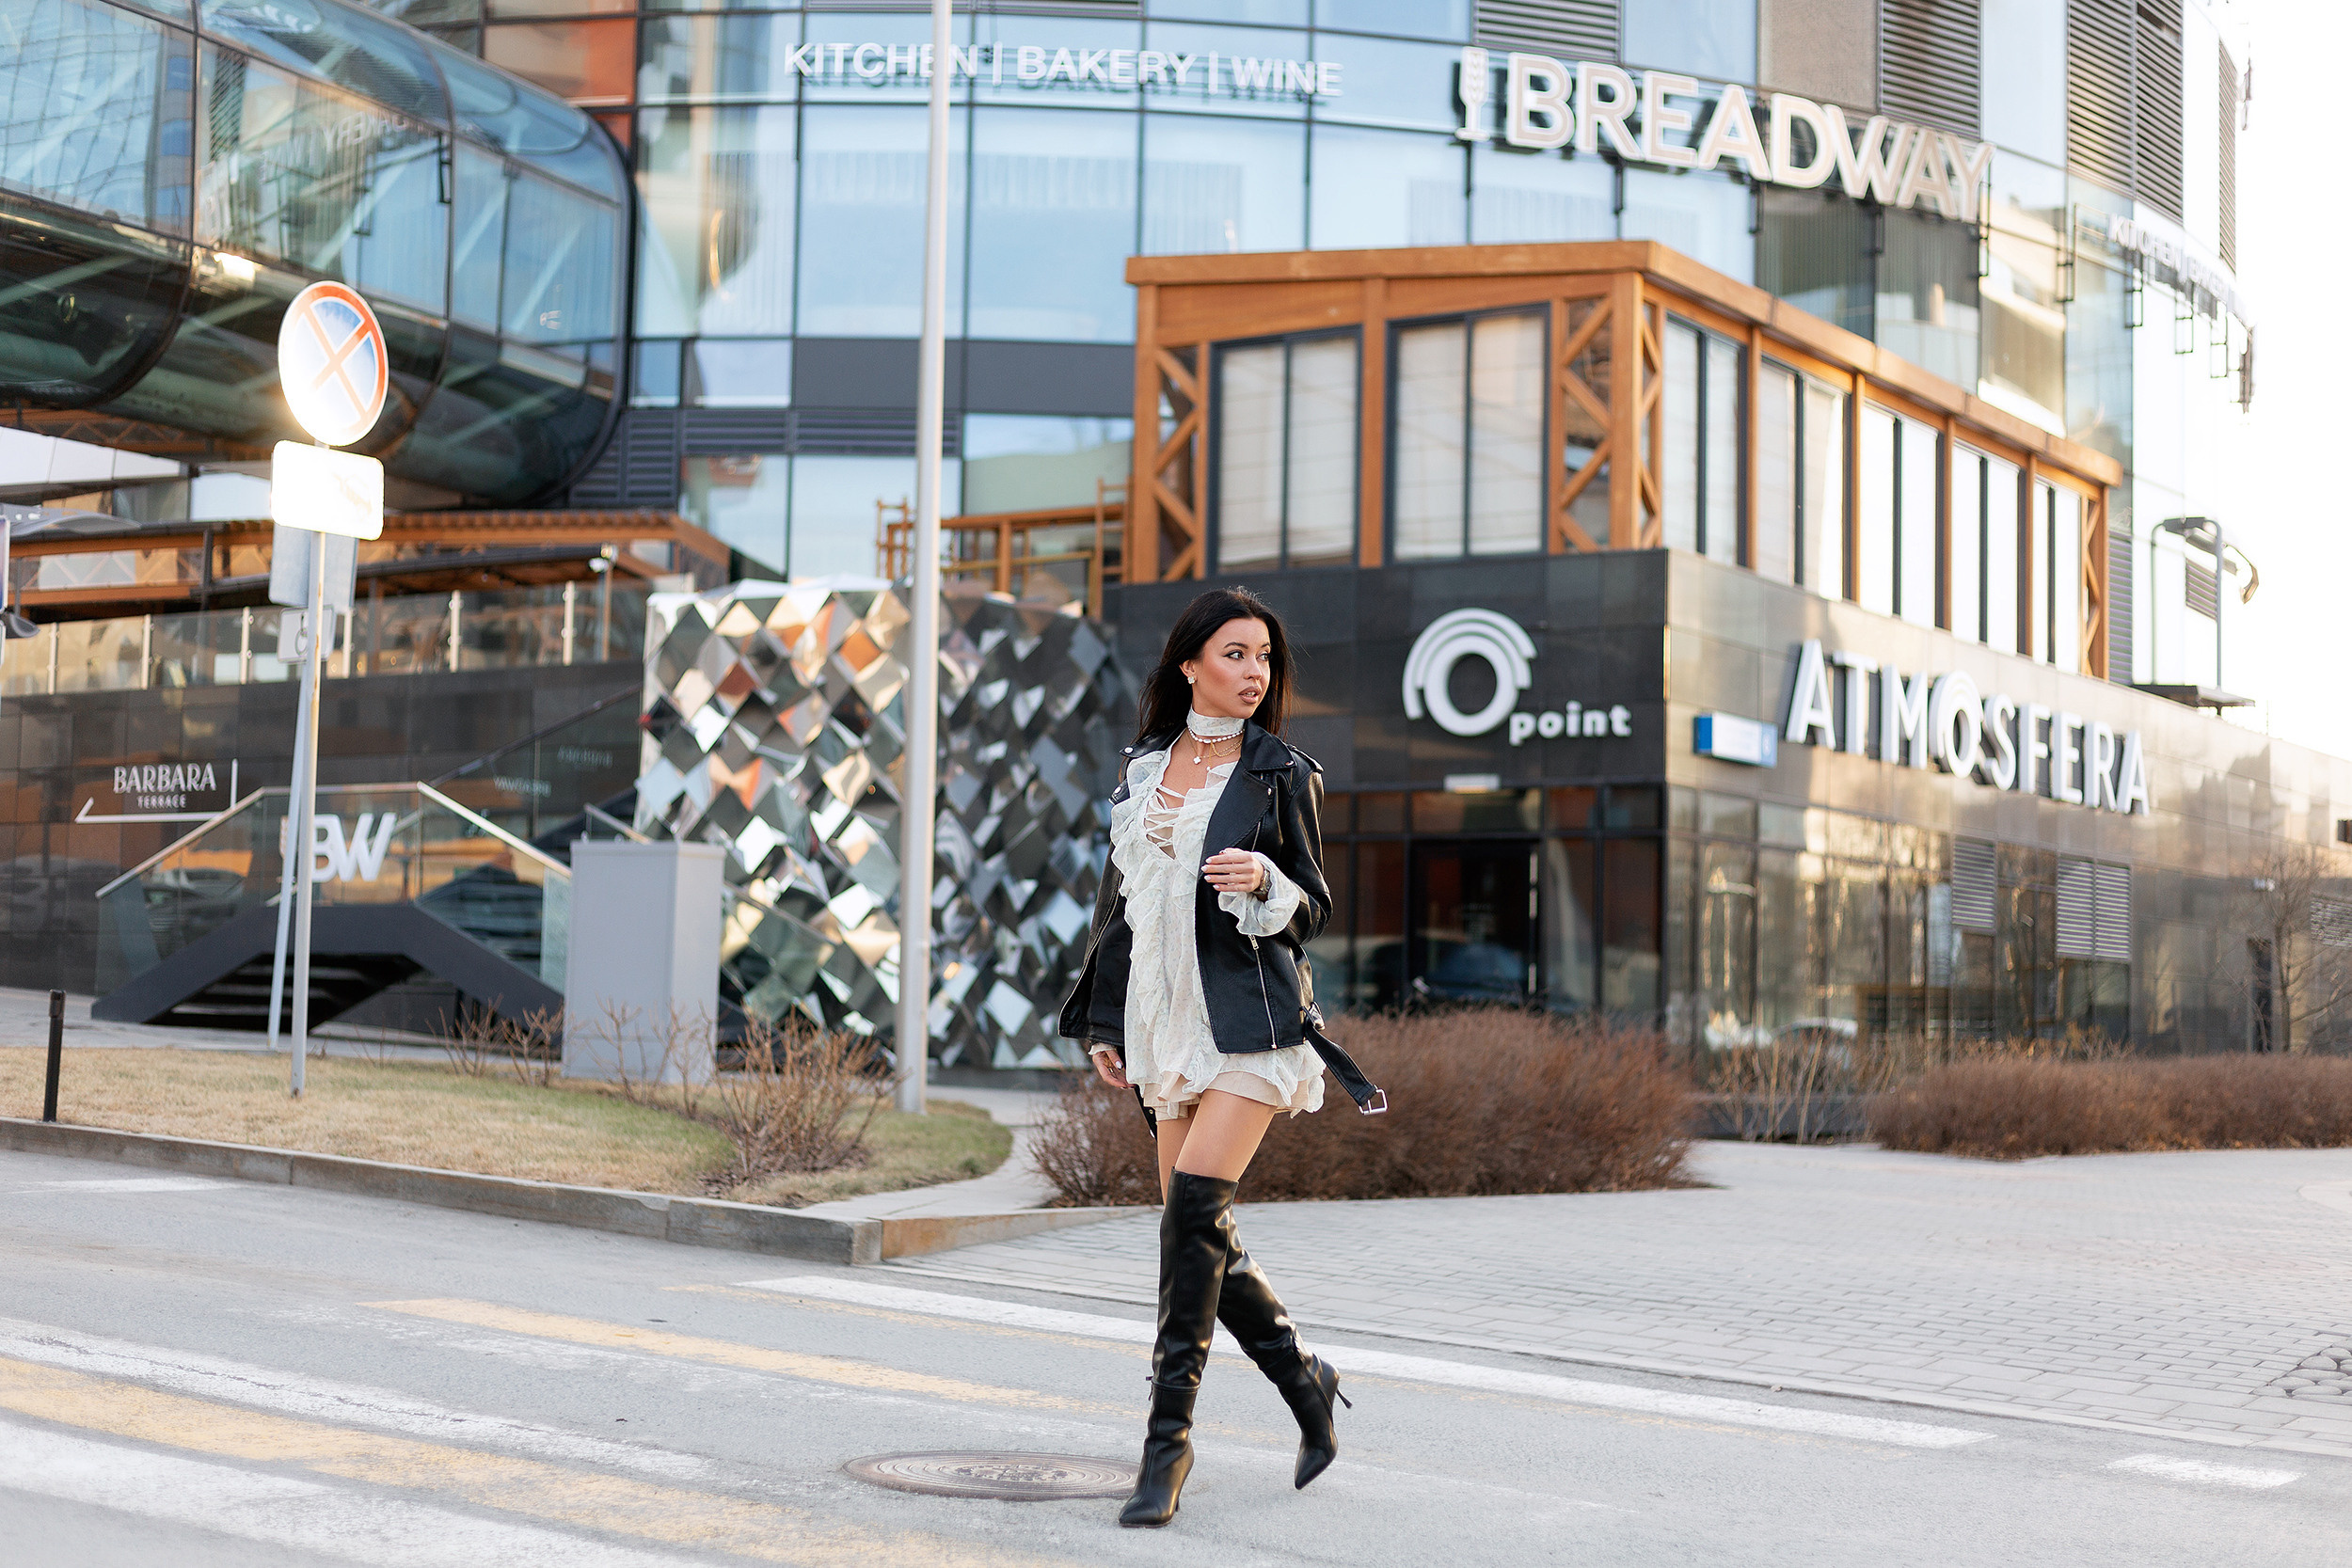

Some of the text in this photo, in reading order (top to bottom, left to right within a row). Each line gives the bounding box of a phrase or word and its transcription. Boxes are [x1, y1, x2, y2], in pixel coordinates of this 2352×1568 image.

[784, 41, 1344, 96] KITCHEN BAKERY WINE
[1505, 51, 1996, 224] BREADWAY
[1509, 700, 1632, 747] point
[1786, 639, 2150, 816] ATMOSFERA
[113, 762, 216, 794] BARBARA
[137, 794, 186, 809] TERRACE
[311, 812, 397, 883] BW
